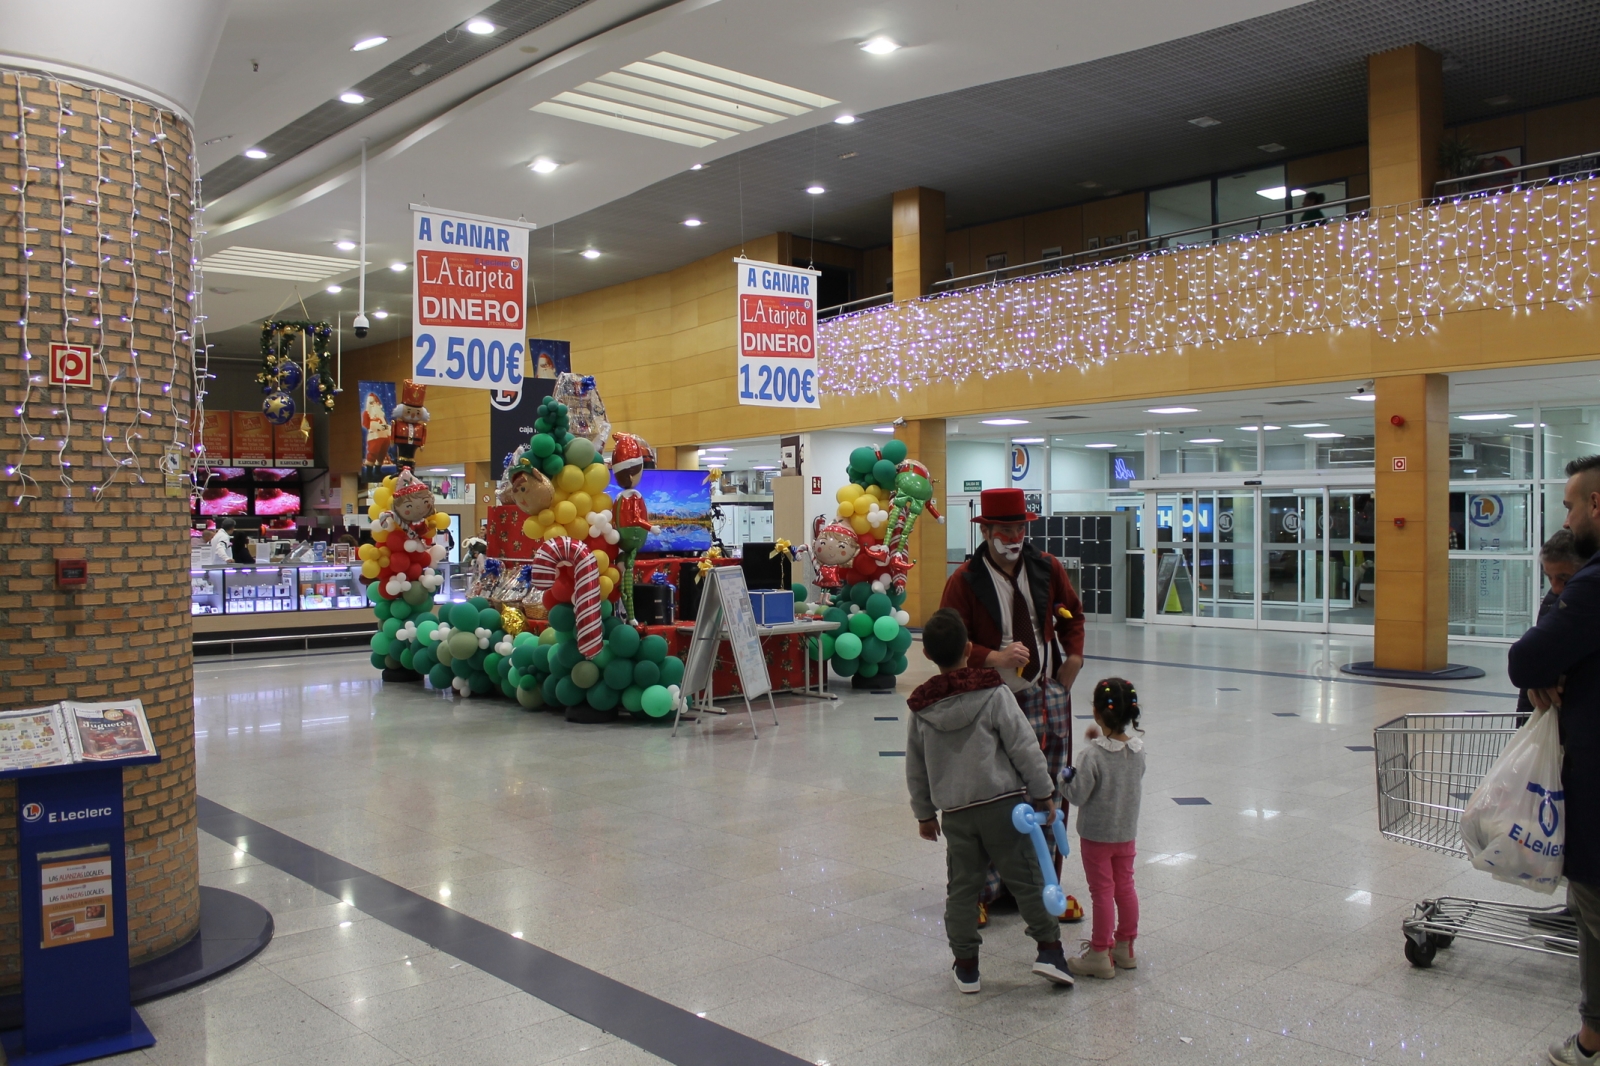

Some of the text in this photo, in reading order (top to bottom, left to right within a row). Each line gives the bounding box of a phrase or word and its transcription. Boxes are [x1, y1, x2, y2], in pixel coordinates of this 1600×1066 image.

[419, 217, 510, 252] A GANAR
[421, 255, 513, 293] LA tarjeta
[747, 267, 809, 295] A GANAR
[422, 296, 520, 323] DINERO
[743, 299, 767, 323] LA
[768, 304, 807, 329] tarjeta
[743, 332, 812, 353] DINERO
[415, 333, 524, 384] 2.500€
[740, 363, 815, 404] 1.200€
[48, 807, 112, 823] E.Leclerc
[59, 872, 83, 881] ALIANZAS
[84, 869, 104, 878] LOCALES
[60, 891, 84, 901] ALIANZAS
[84, 888, 105, 897] LOCALES
